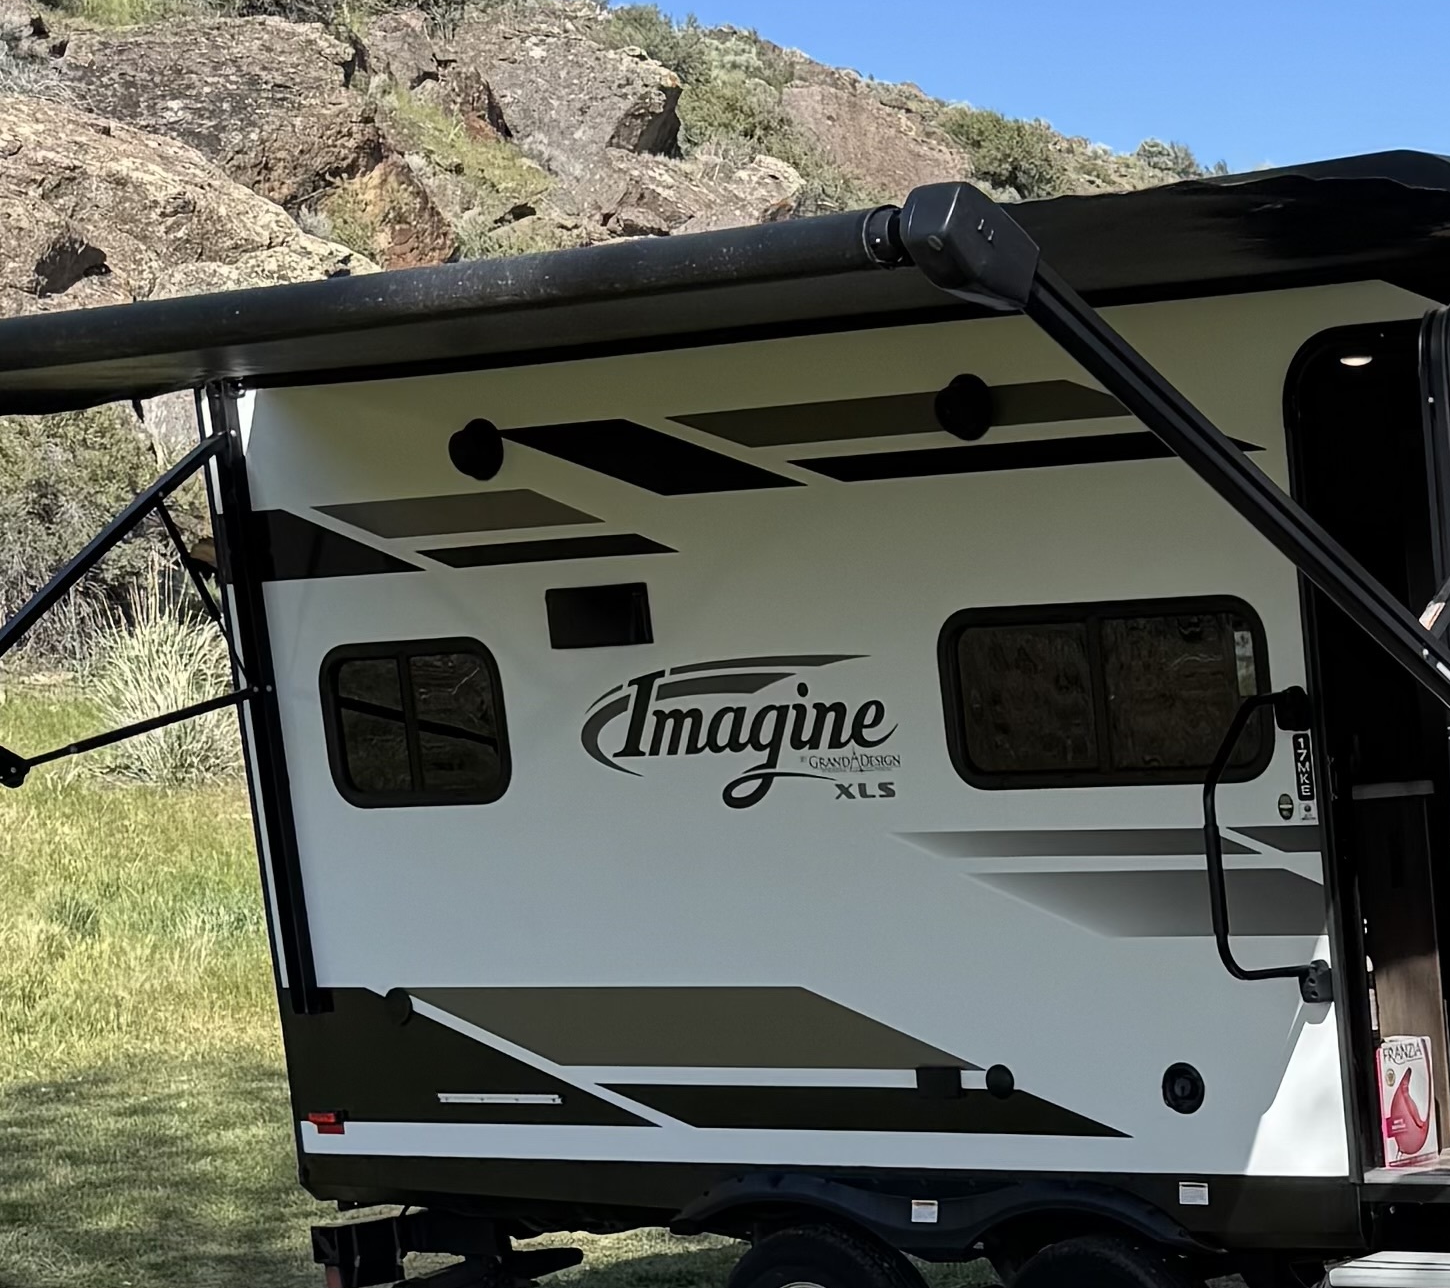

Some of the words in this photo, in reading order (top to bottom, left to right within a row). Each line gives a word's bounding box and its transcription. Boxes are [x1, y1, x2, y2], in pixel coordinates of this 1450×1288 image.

[612, 669, 899, 809] Imagine
[808, 755, 850, 770] GRAND
[860, 753, 901, 767] DESIGN
[1296, 737, 1311, 796] 17MKE
[834, 781, 896, 800] XLS
[1383, 1041, 1423, 1065] FRANZIA
